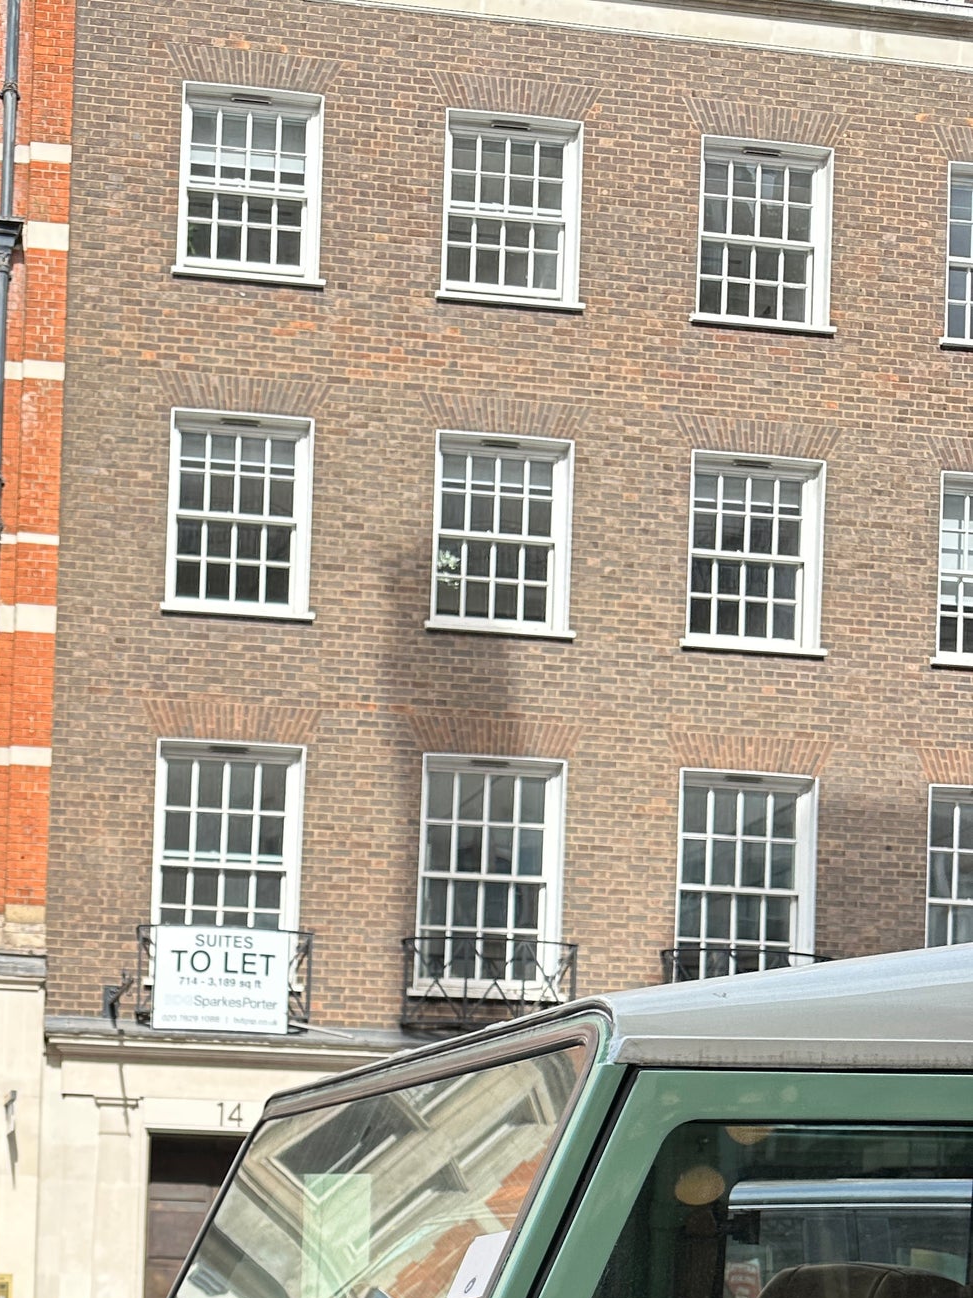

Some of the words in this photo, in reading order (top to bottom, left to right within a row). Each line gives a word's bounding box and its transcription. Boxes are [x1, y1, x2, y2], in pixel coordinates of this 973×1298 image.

[195, 933, 254, 949] SUITES
[171, 950, 211, 973] TO
[224, 951, 276, 976] LET
[179, 976, 198, 986] 714
[239, 980, 251, 989] sq
[255, 979, 262, 989] ft
[217, 1102, 243, 1127] 14
